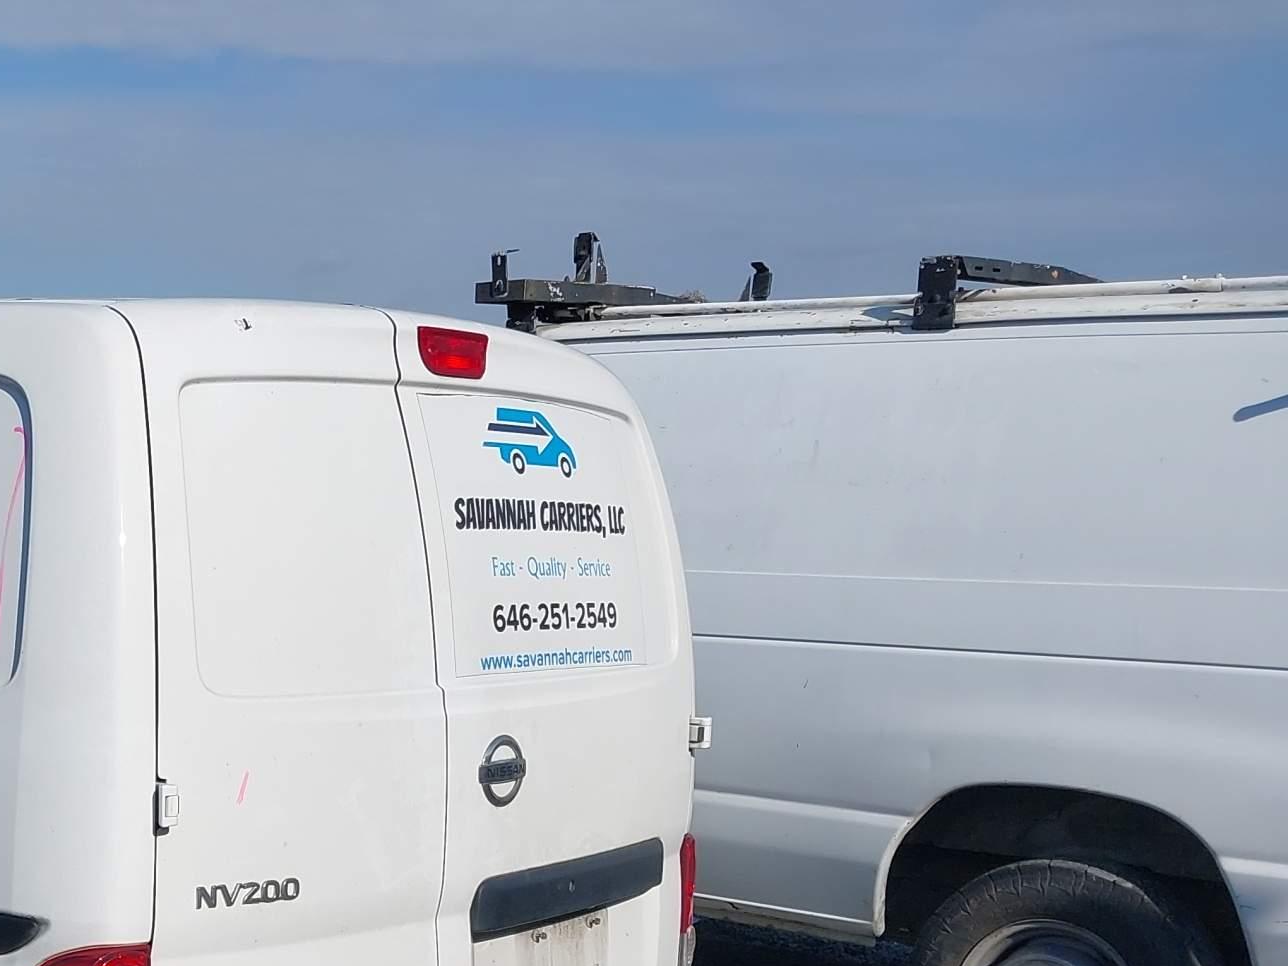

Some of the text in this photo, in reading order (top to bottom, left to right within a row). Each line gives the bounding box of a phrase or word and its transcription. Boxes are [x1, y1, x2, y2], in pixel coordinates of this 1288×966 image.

[454, 497, 626, 538] SAVANNAH CARRIERS, LLC
[492, 556, 516, 577] Fast
[527, 556, 567, 579] Quality
[577, 556, 611, 577] Service
[492, 602, 617, 633] 646-251-2549
[480, 646, 633, 671] www.savannahcarriers.com
[487, 764, 525, 778] NISSAN
[196, 878, 300, 909] NV200
